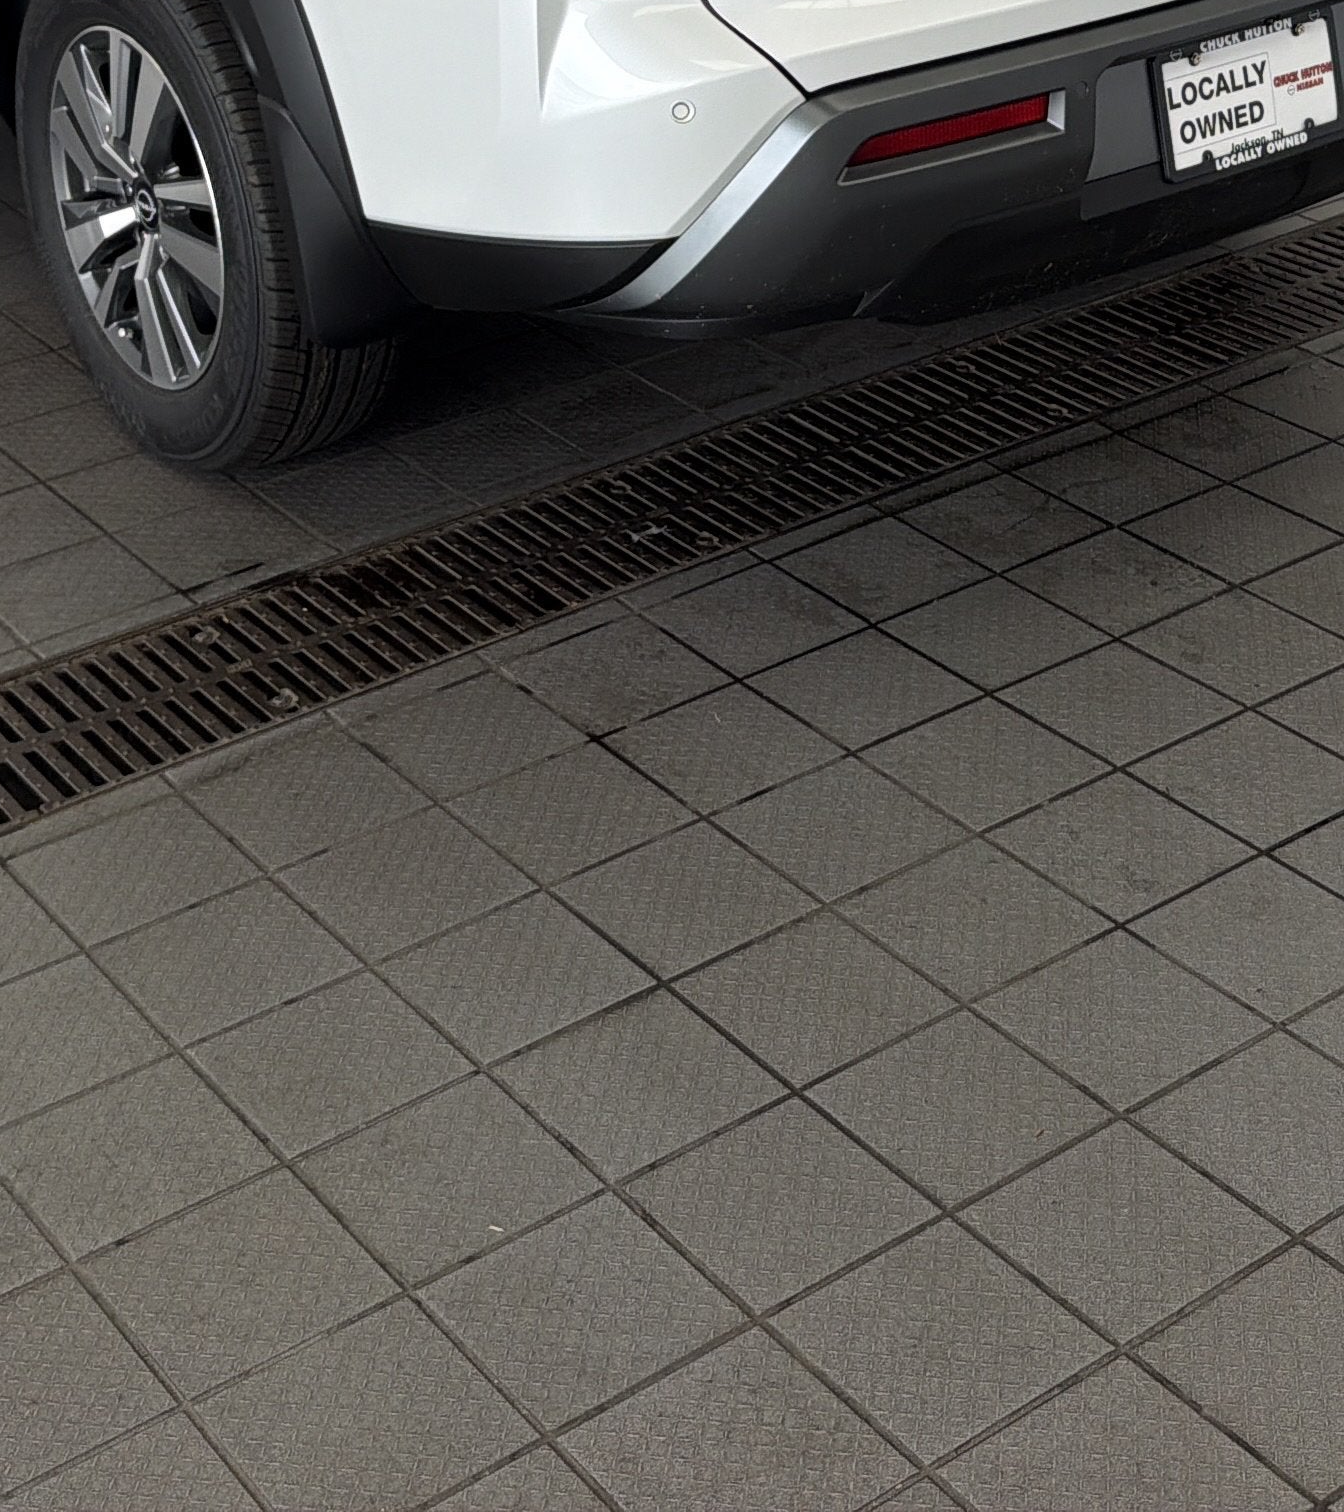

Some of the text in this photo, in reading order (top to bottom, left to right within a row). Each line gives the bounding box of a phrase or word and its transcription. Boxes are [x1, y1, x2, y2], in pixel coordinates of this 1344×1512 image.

[1199, 31, 1241, 54] CHUCK
[1167, 60, 1267, 111] LOCALLY
[1273, 71, 1299, 88] CHUCK
[1296, 77, 1324, 92] NISSAN
[1180, 100, 1265, 144] OWNED
[1215, 131, 1308, 171] LOCALLY OWNED
